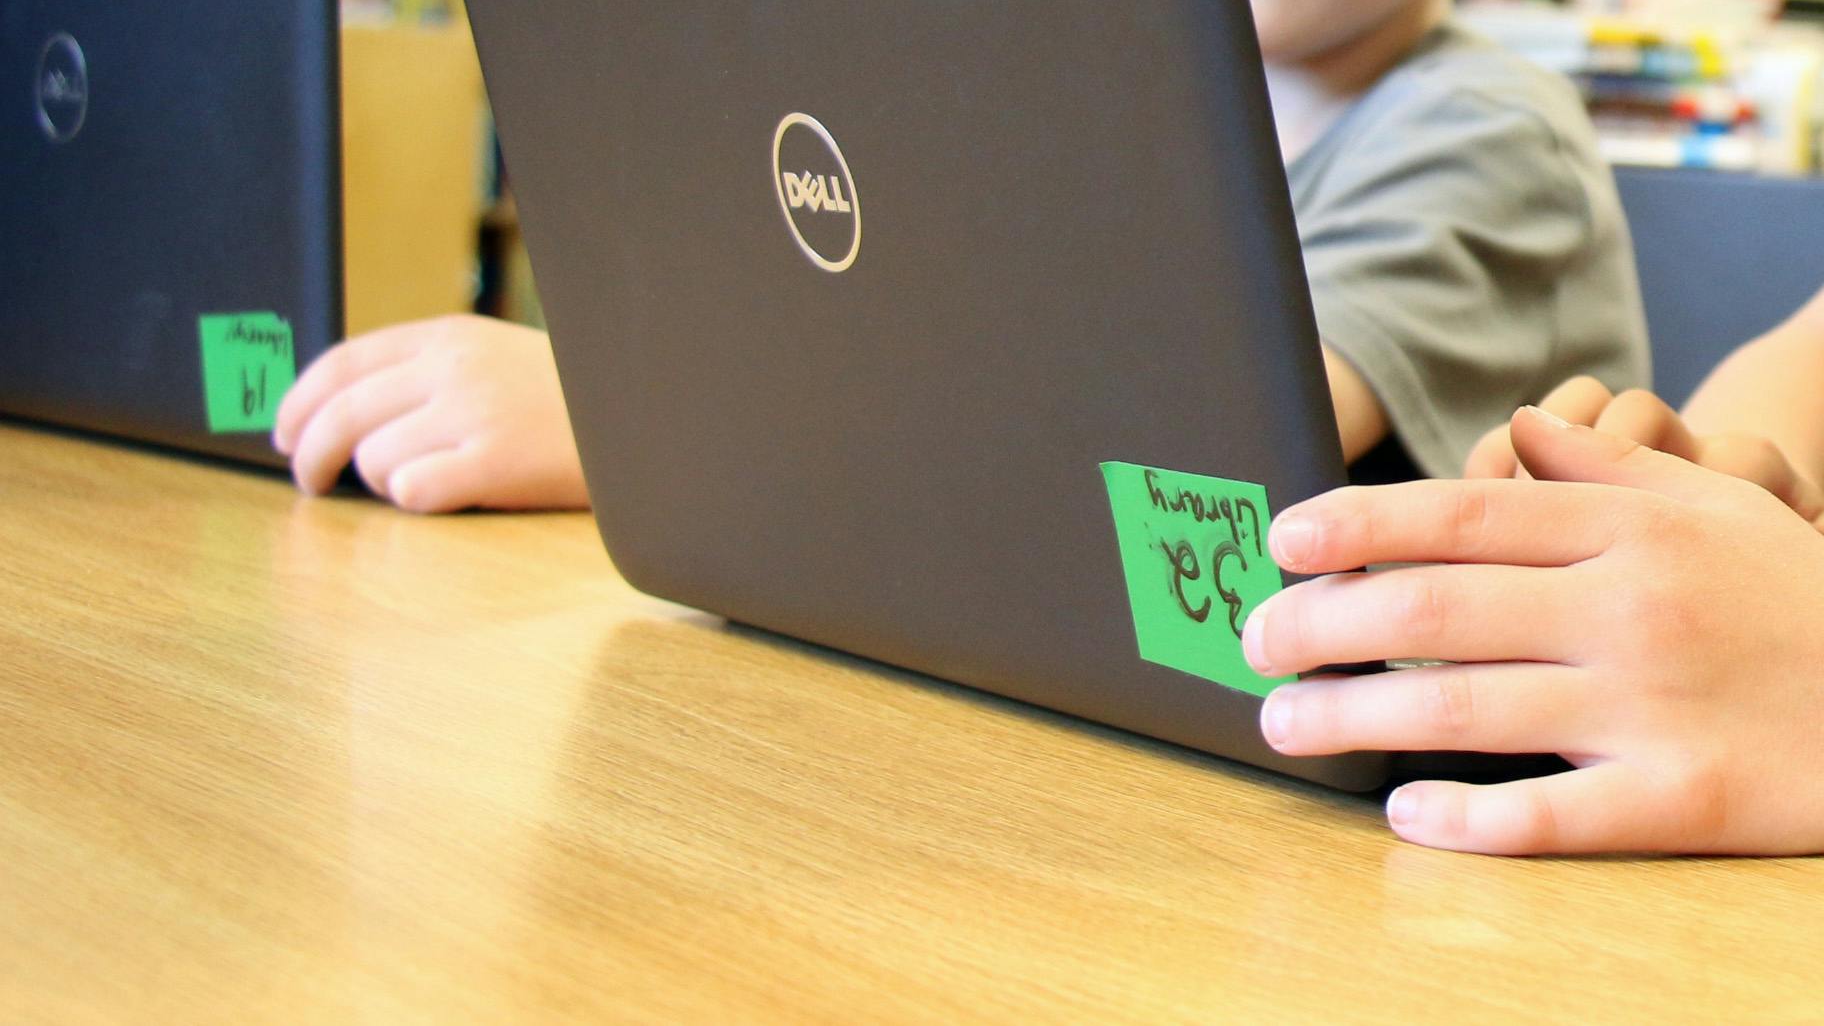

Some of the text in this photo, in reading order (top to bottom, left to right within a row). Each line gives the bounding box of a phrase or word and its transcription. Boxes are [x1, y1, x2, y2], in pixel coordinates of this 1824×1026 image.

[782, 169, 852, 213] DELL
[1143, 468, 1263, 558] Library
[1160, 536, 1249, 641] 32
